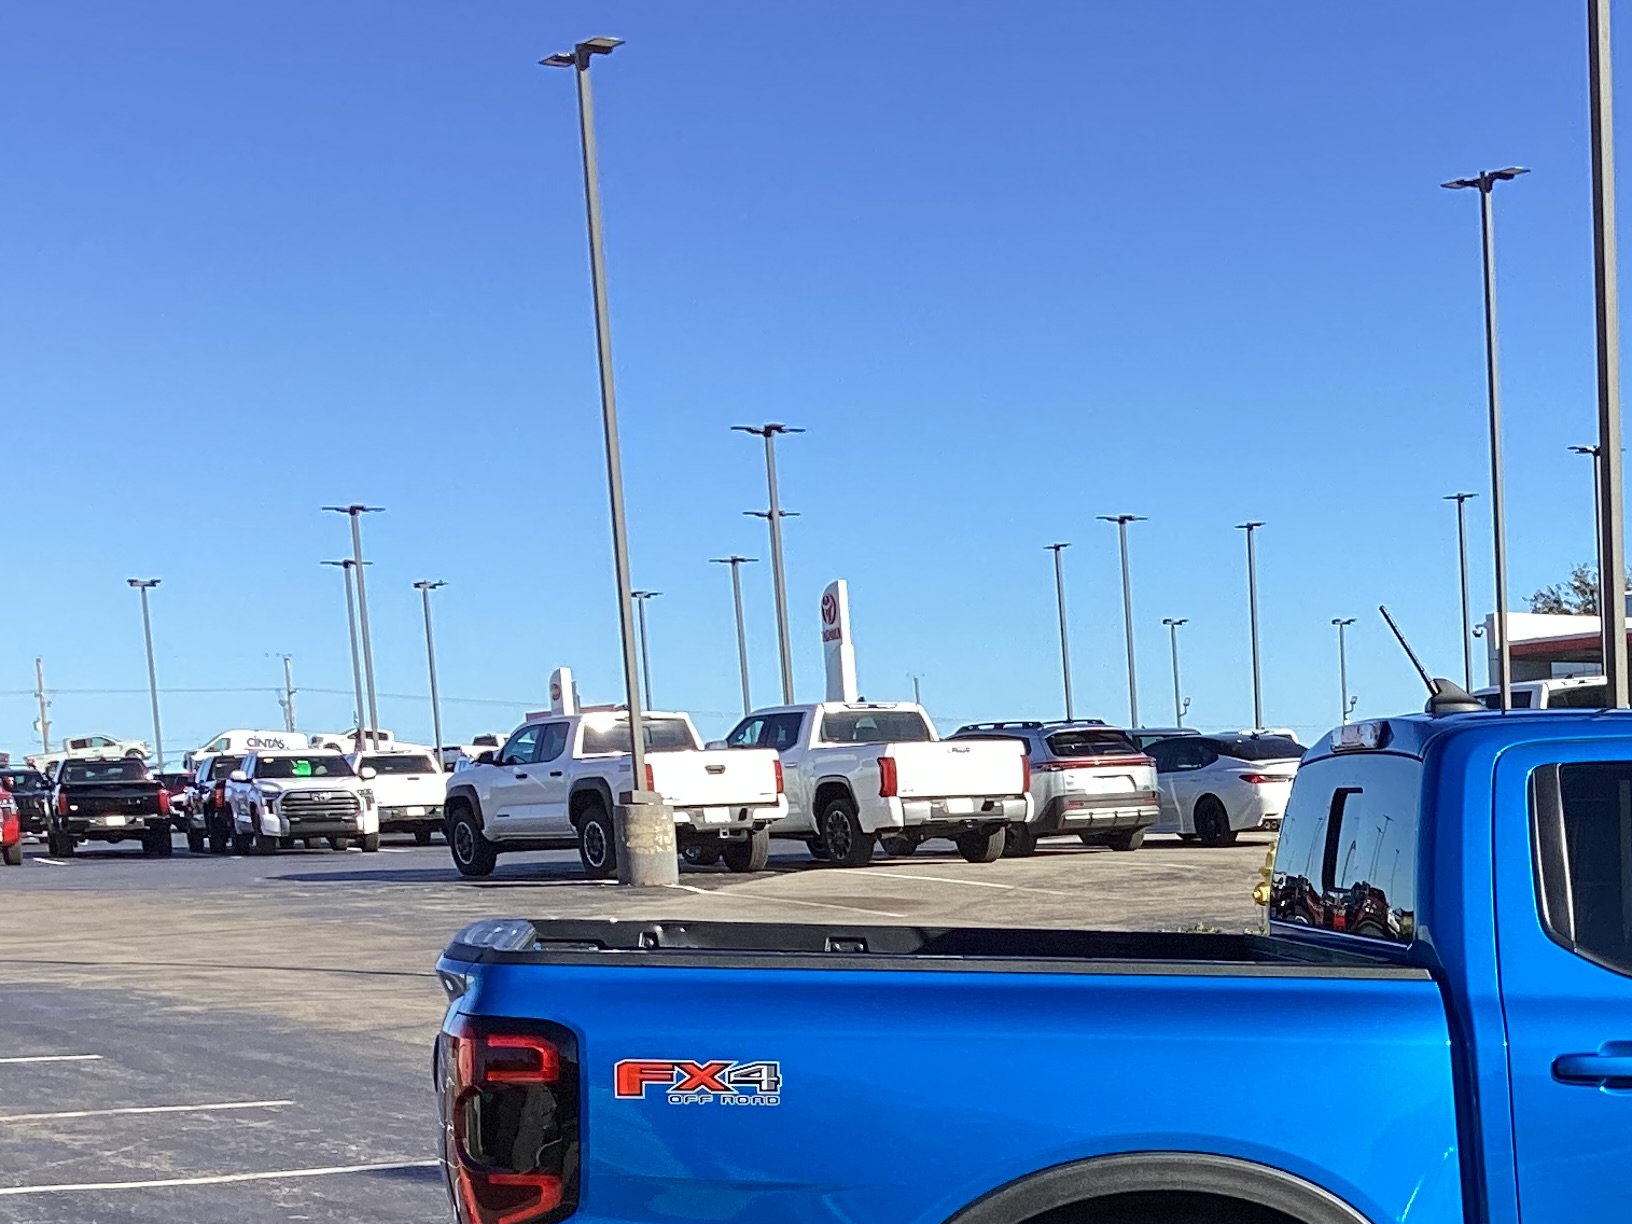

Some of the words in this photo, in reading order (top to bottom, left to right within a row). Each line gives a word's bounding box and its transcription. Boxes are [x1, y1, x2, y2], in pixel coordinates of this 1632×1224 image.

[614, 1059, 783, 1099] FX4
[668, 1094, 713, 1105] OFF
[720, 1094, 781, 1106] ROAD
